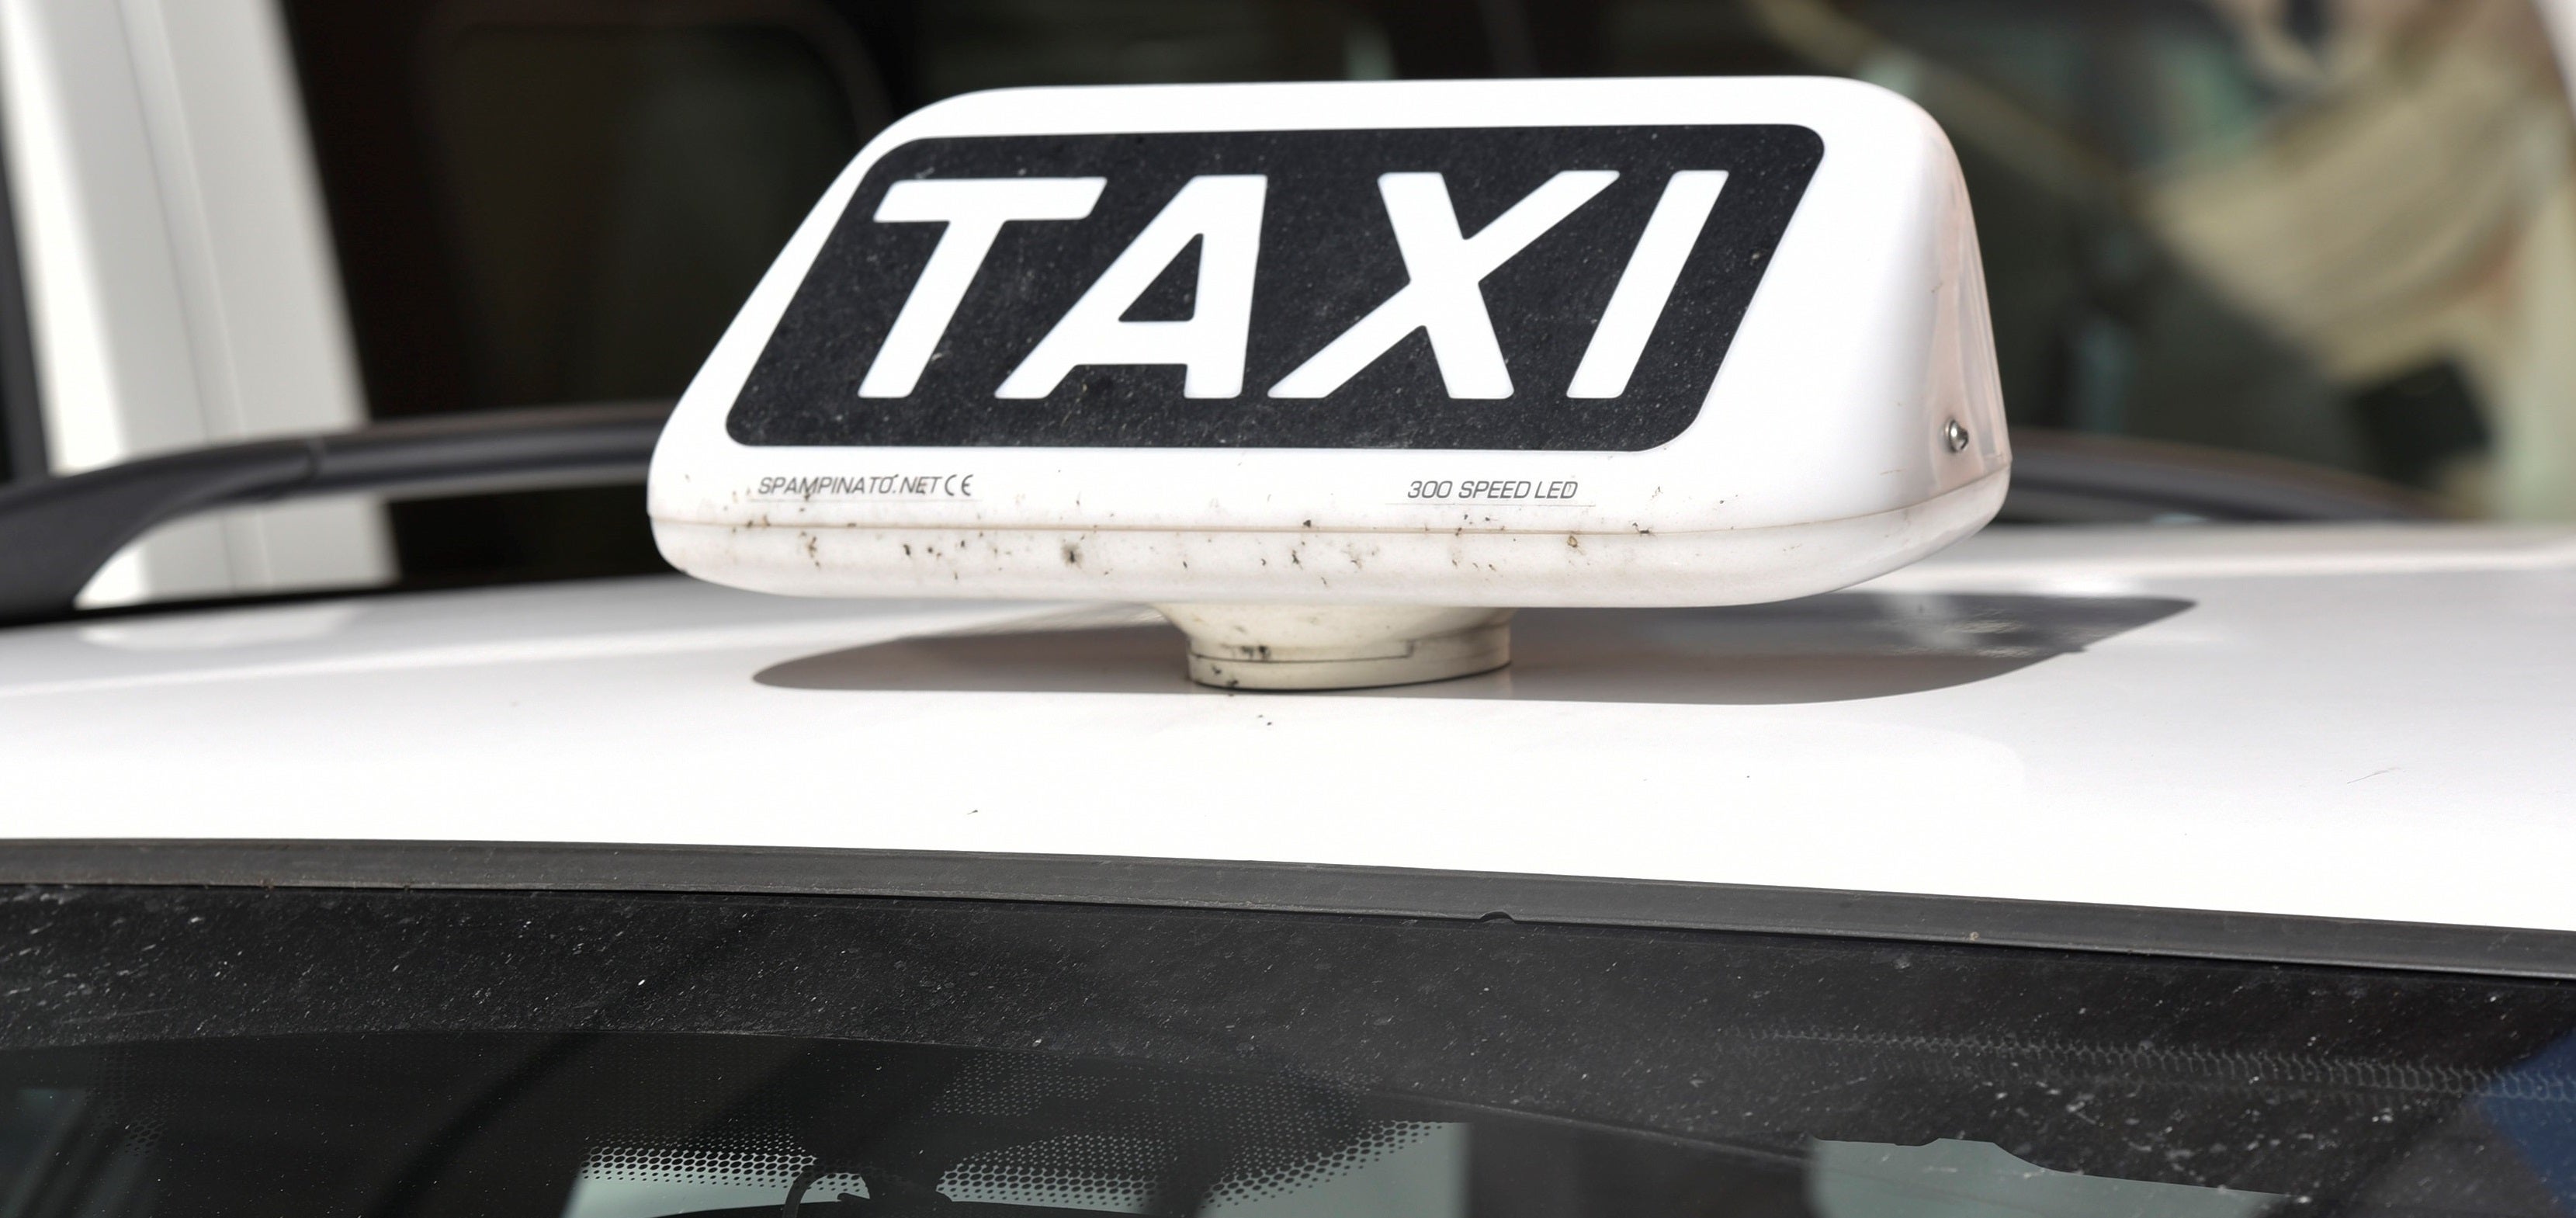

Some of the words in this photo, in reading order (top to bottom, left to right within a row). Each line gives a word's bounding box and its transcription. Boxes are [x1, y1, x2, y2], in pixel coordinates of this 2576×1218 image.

[857, 169, 1729, 401] TAXI
[758, 476, 942, 495] SPAMPINATO.NET
[1407, 480, 1453, 499] 300
[1458, 480, 1531, 499] SPEED
[1534, 480, 1579, 499] LED
